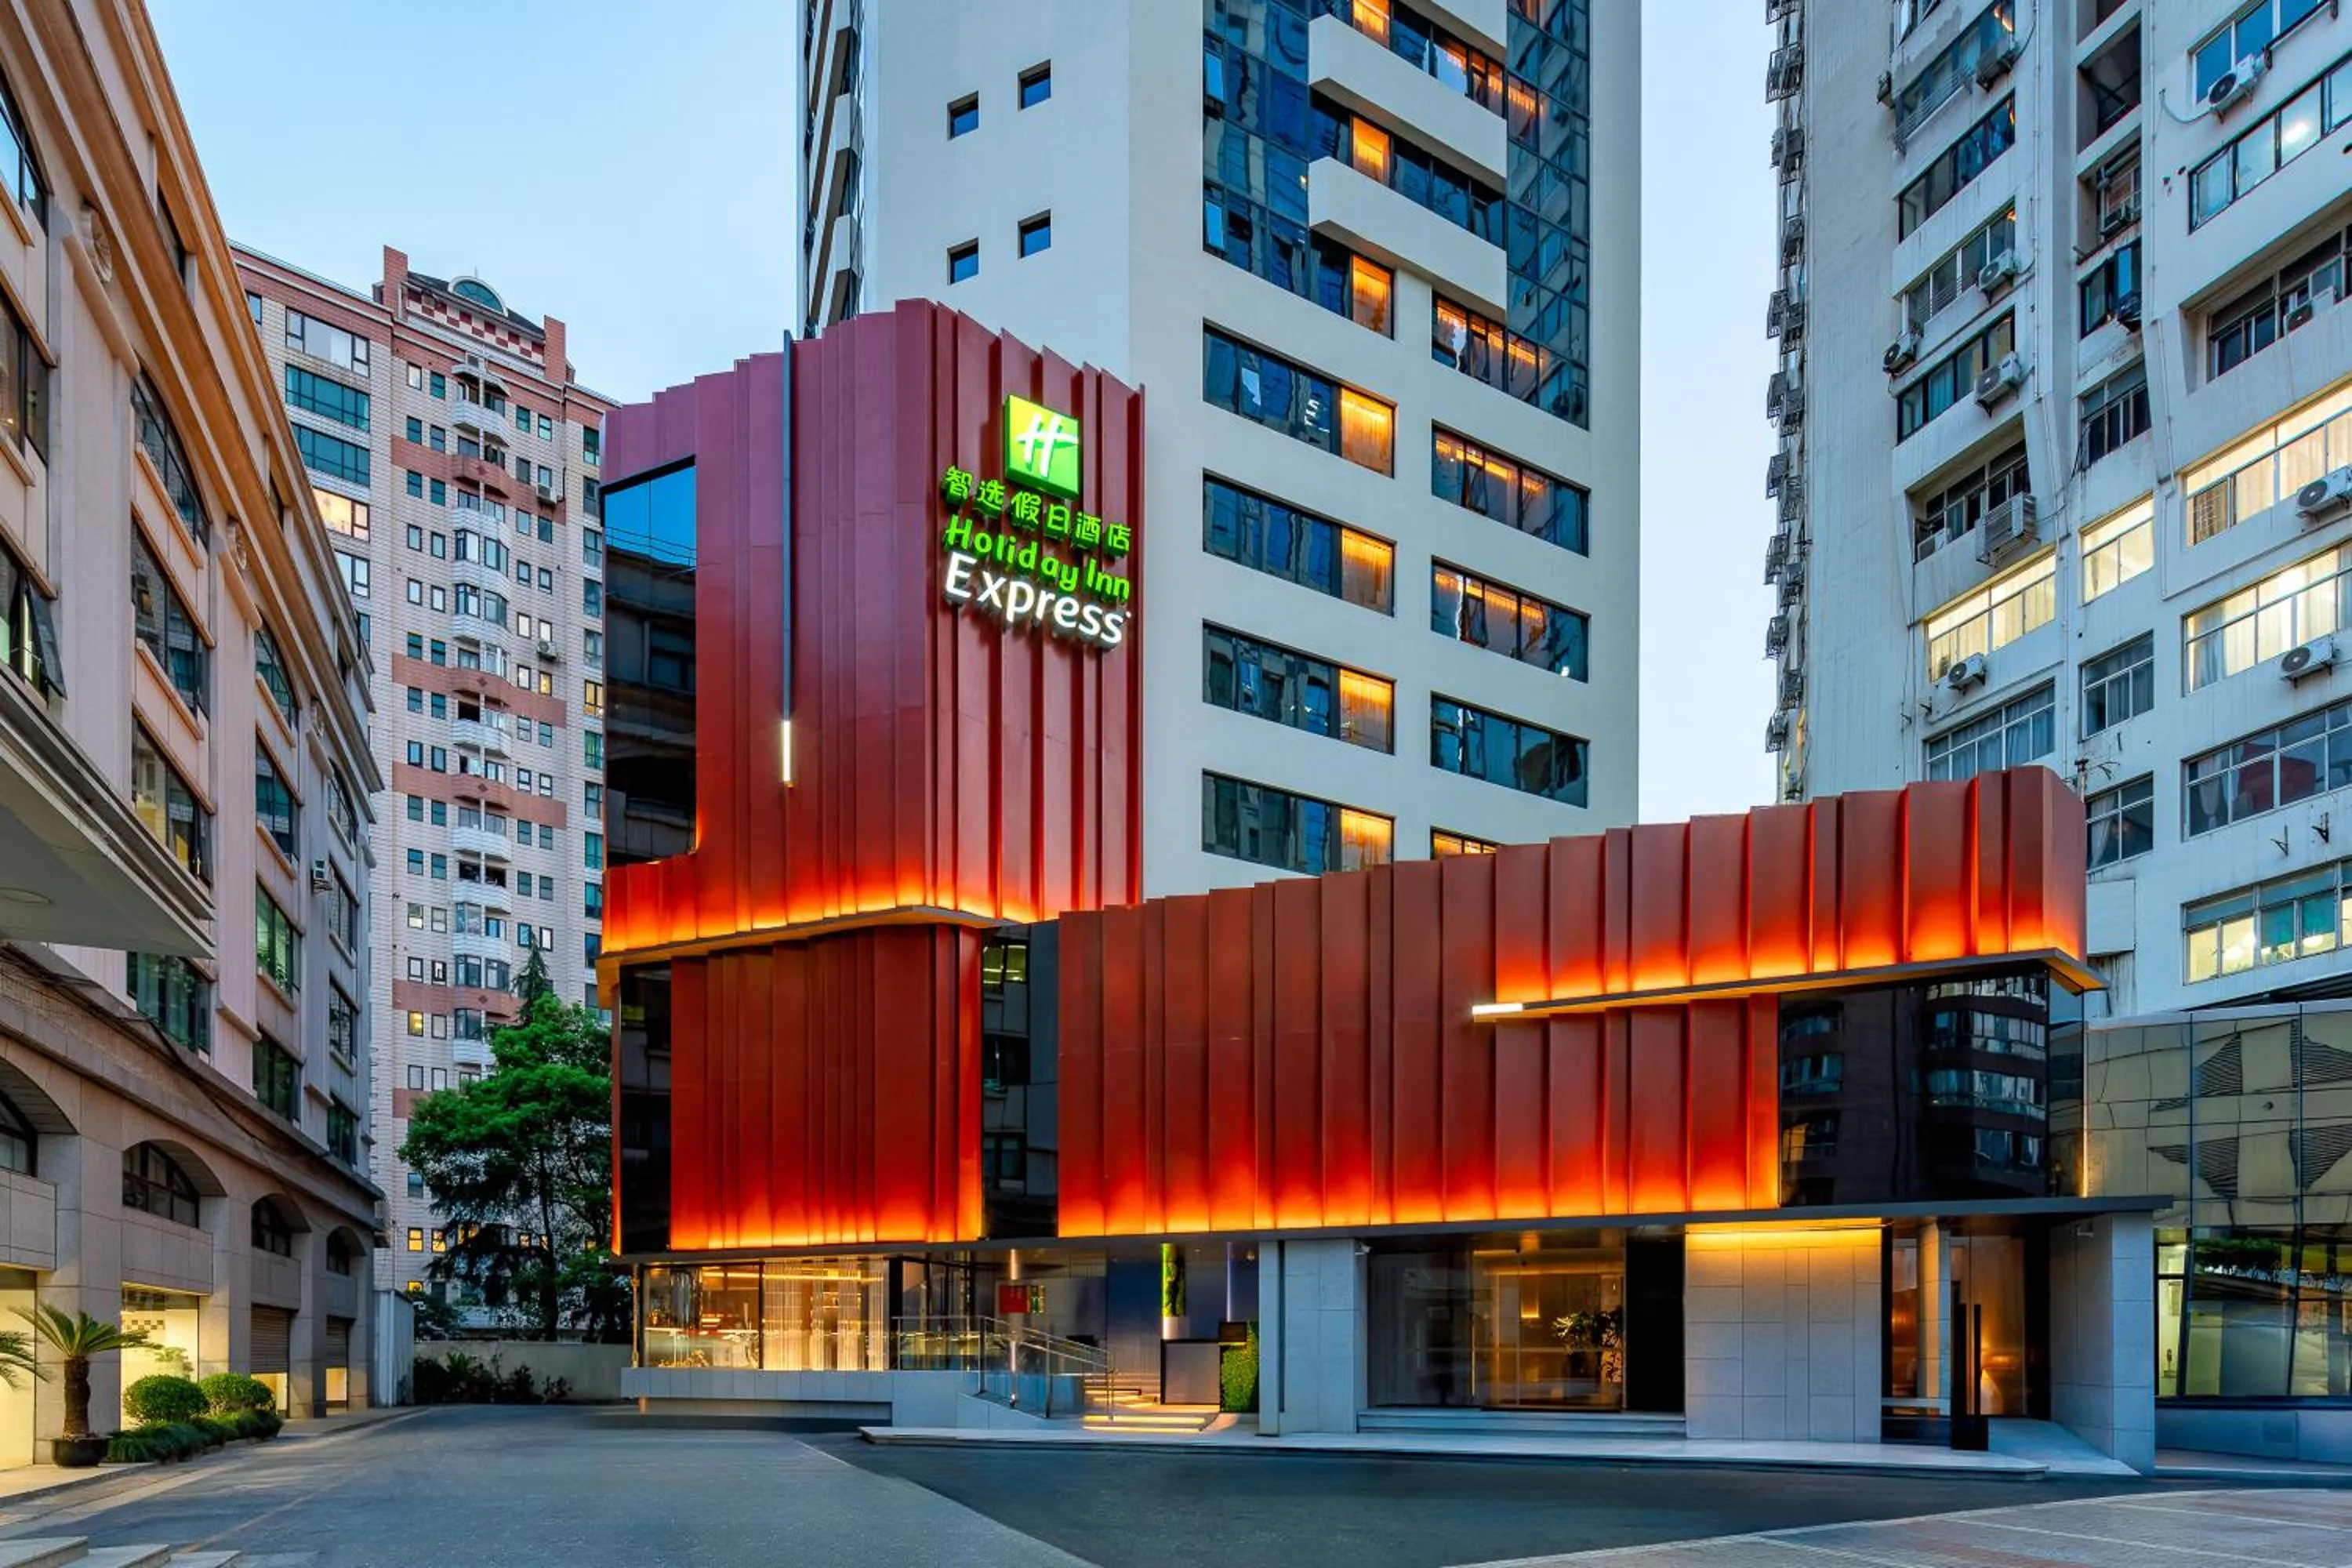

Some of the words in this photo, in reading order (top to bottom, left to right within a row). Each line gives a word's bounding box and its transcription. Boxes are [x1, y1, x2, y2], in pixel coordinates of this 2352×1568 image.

[944, 465, 1131, 554] 智选假日酒店
[945, 514, 1079, 591] Holiday
[1086, 558, 1130, 601] Inn
[945, 551, 1124, 644] Express
